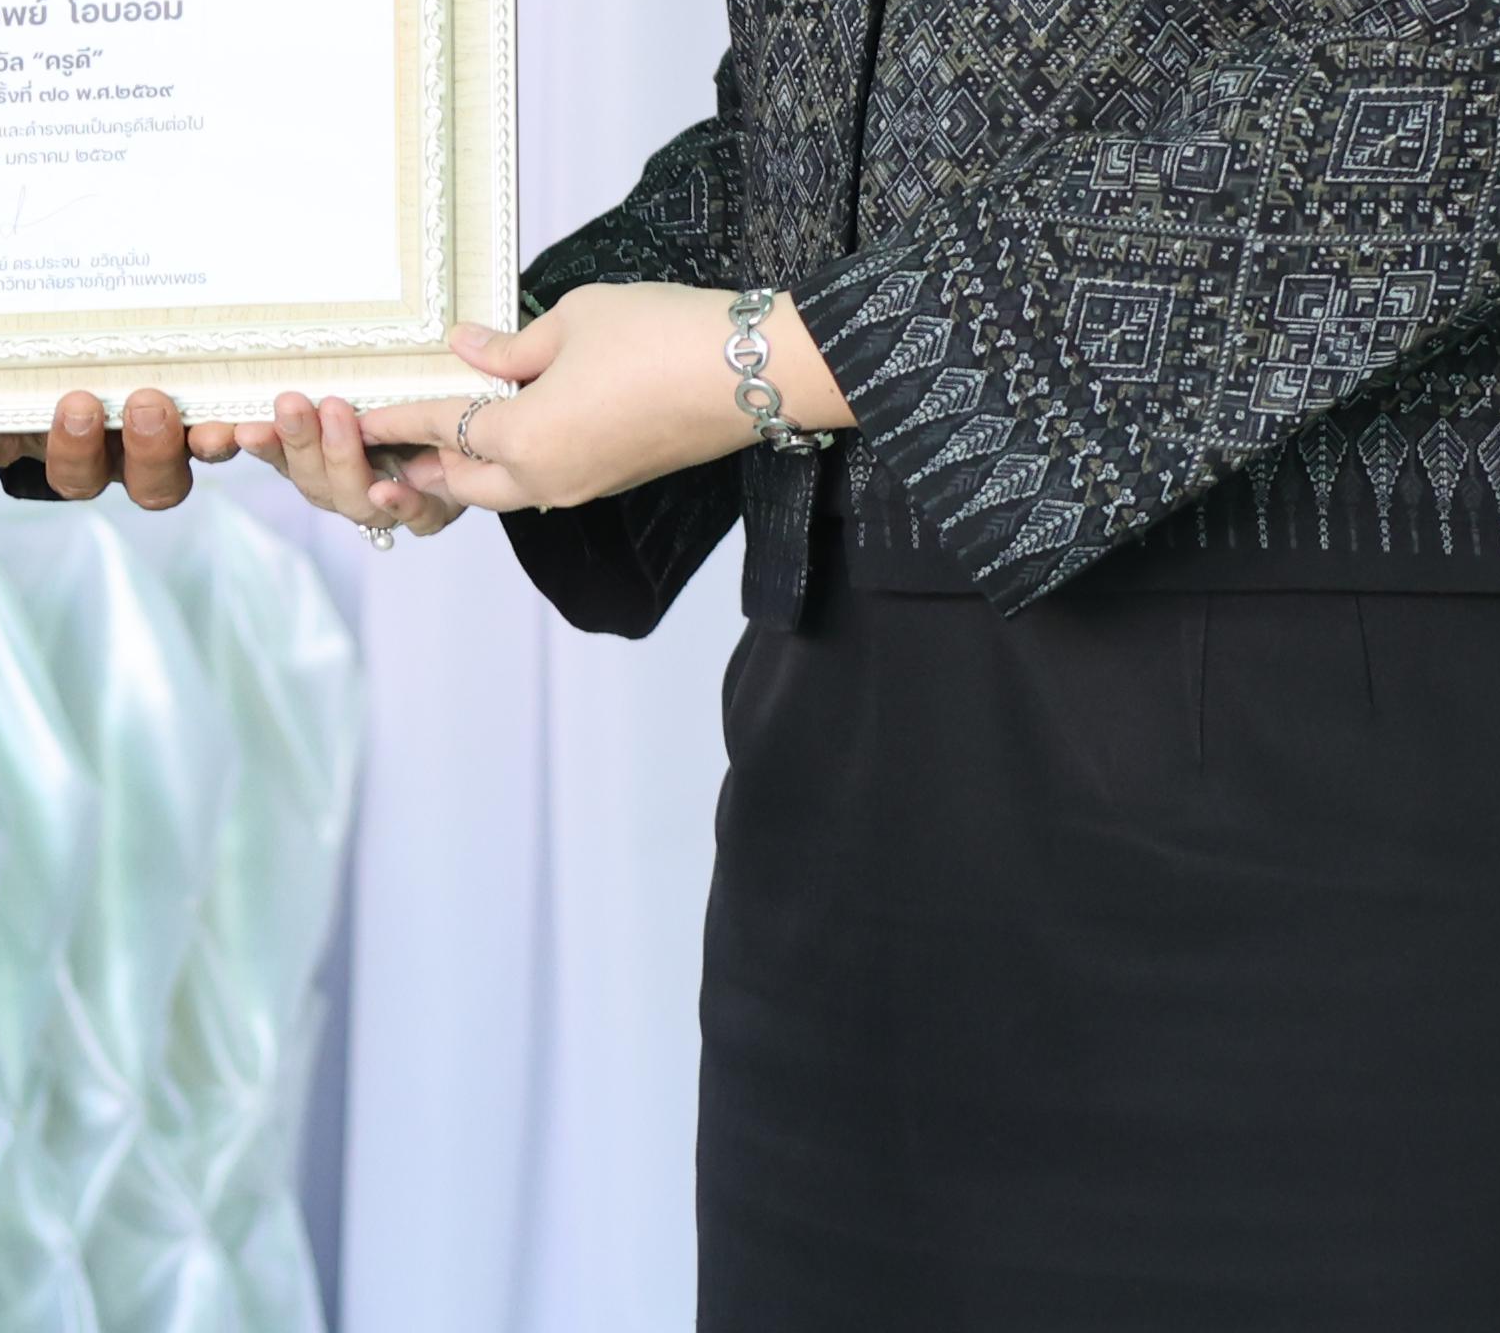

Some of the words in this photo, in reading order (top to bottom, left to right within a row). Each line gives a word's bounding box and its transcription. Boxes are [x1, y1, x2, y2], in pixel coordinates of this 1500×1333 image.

[32, 45, 104, 78] “ครูดี”
[5, 151, 70, 166] มกราคม
